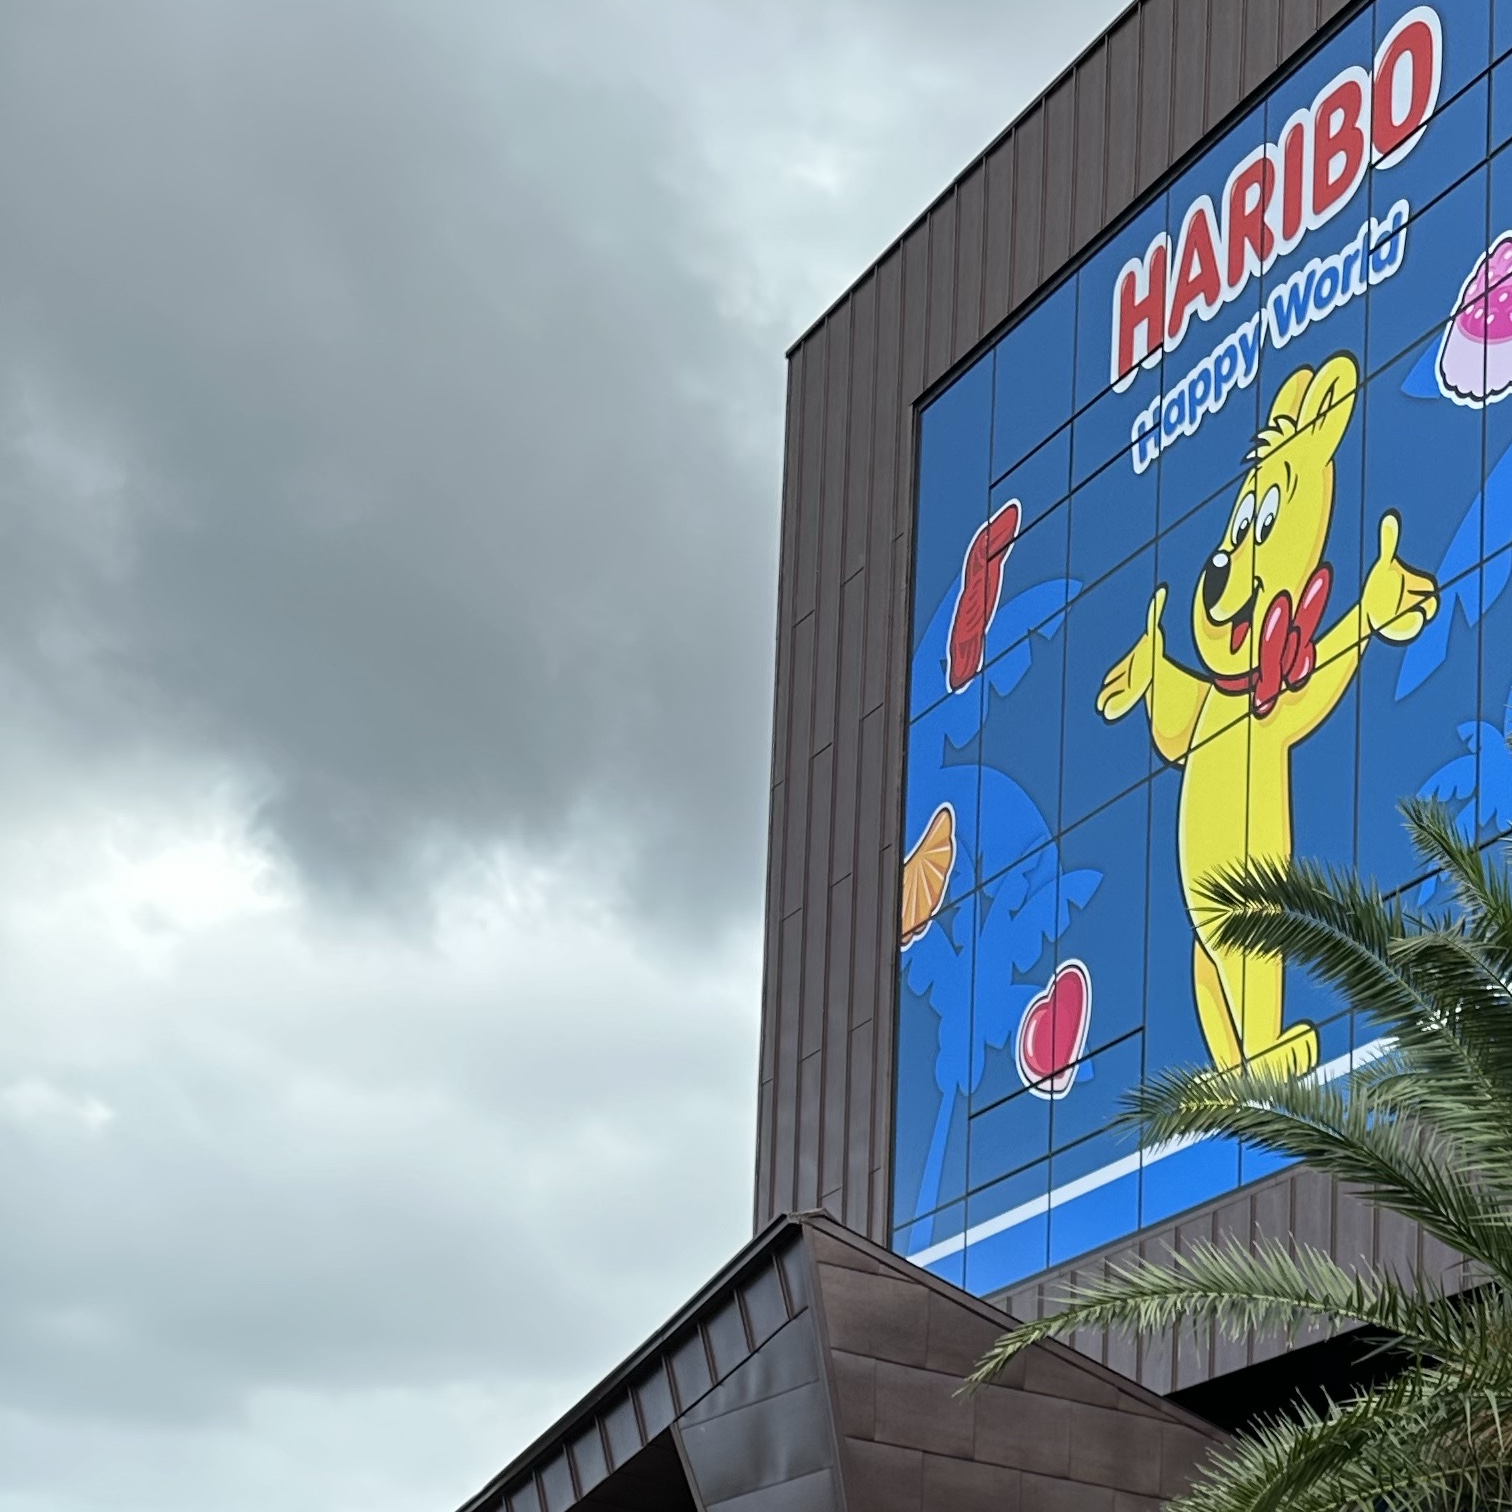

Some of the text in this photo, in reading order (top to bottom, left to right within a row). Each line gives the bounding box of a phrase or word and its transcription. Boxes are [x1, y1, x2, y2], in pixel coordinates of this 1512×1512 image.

[1114, 15, 1438, 385] HARIBO
[1134, 208, 1406, 468] Happy World
